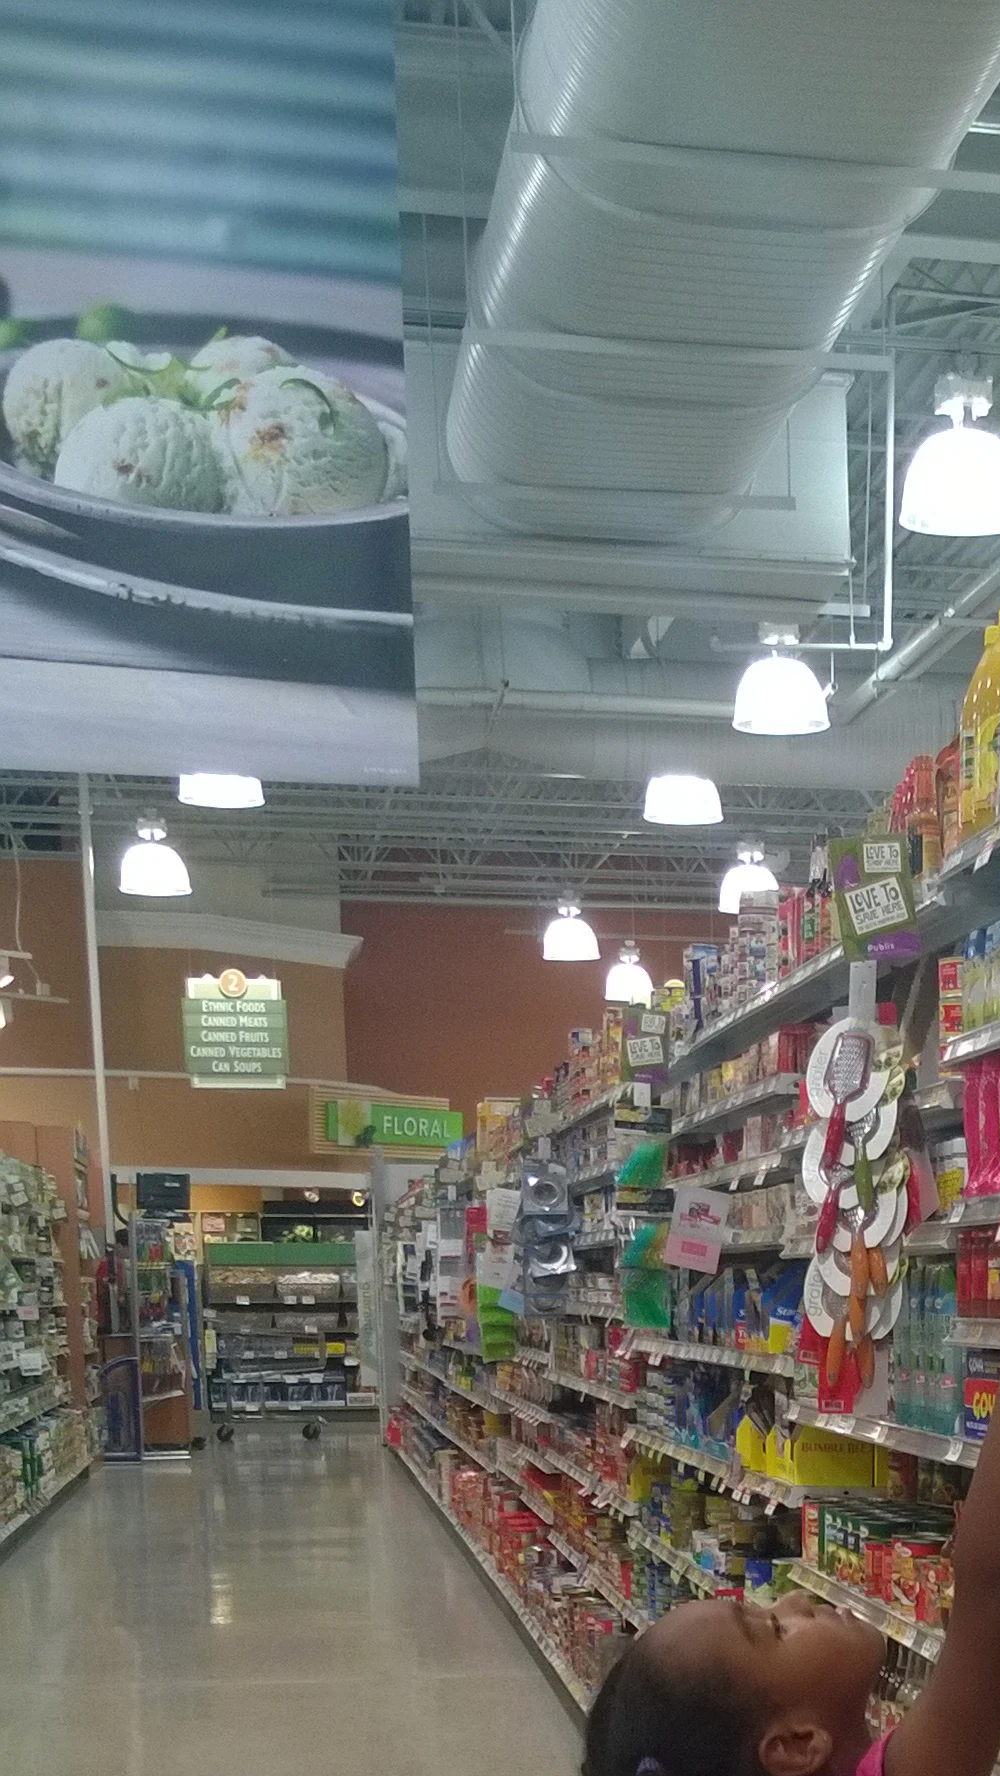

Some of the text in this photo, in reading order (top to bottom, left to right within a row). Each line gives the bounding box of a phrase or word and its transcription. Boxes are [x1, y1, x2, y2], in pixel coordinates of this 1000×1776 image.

[866, 845, 885, 860] LOVE
[849, 886, 881, 914] LOVE
[855, 909, 880, 925] SAVE
[227, 974, 238, 992] 2
[202, 1000, 266, 1013] ETHNIC FOODS
[201, 1015, 268, 1028] CANNED MEATS
[201, 1030, 269, 1043] CANNED FRUITS
[190, 1045, 282, 1058] CANNED VEGETABLES
[212, 1060, 262, 1073] CAN SOUPS
[382, 1114, 452, 1139] FLORAL
